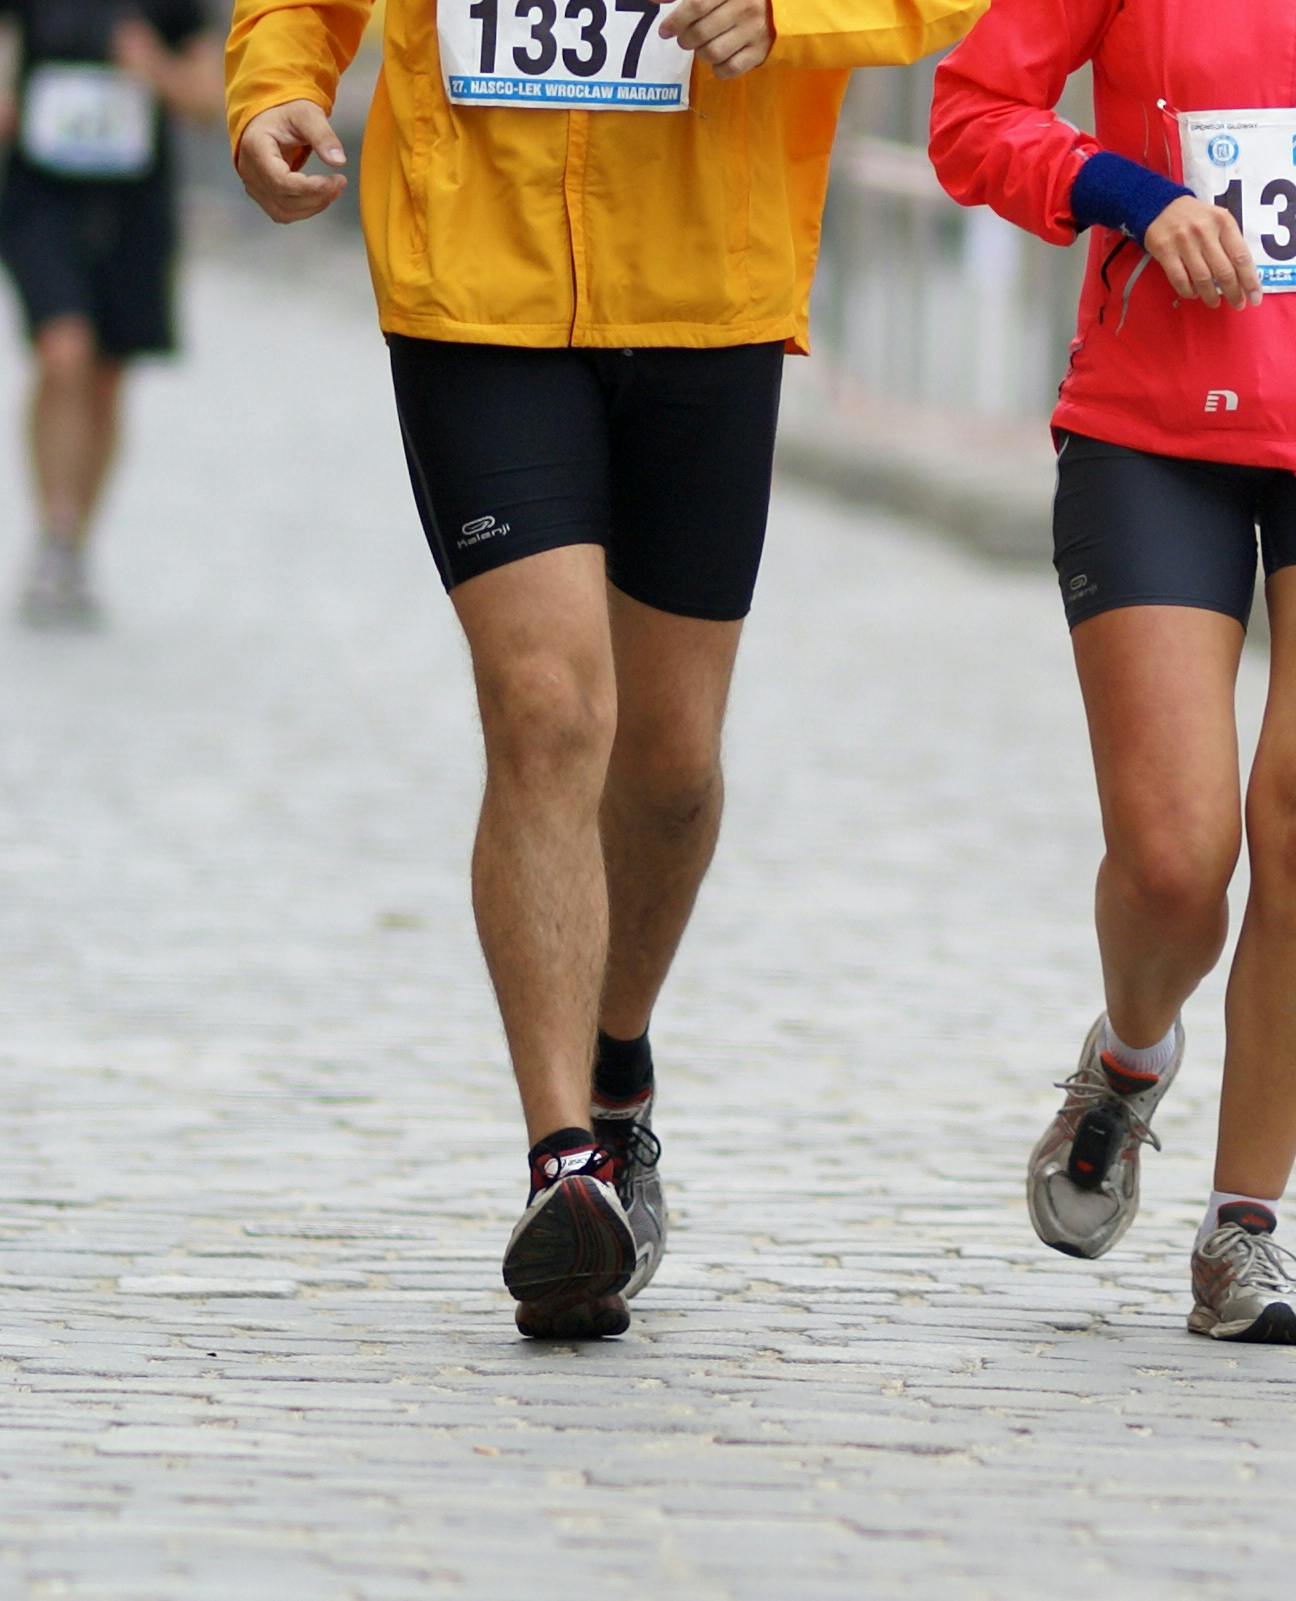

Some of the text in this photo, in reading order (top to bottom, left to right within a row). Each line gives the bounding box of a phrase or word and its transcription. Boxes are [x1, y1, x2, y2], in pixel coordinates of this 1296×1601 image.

[451, 80, 678, 101] 27. HASCO-LEK WROCŁAW MARATON
